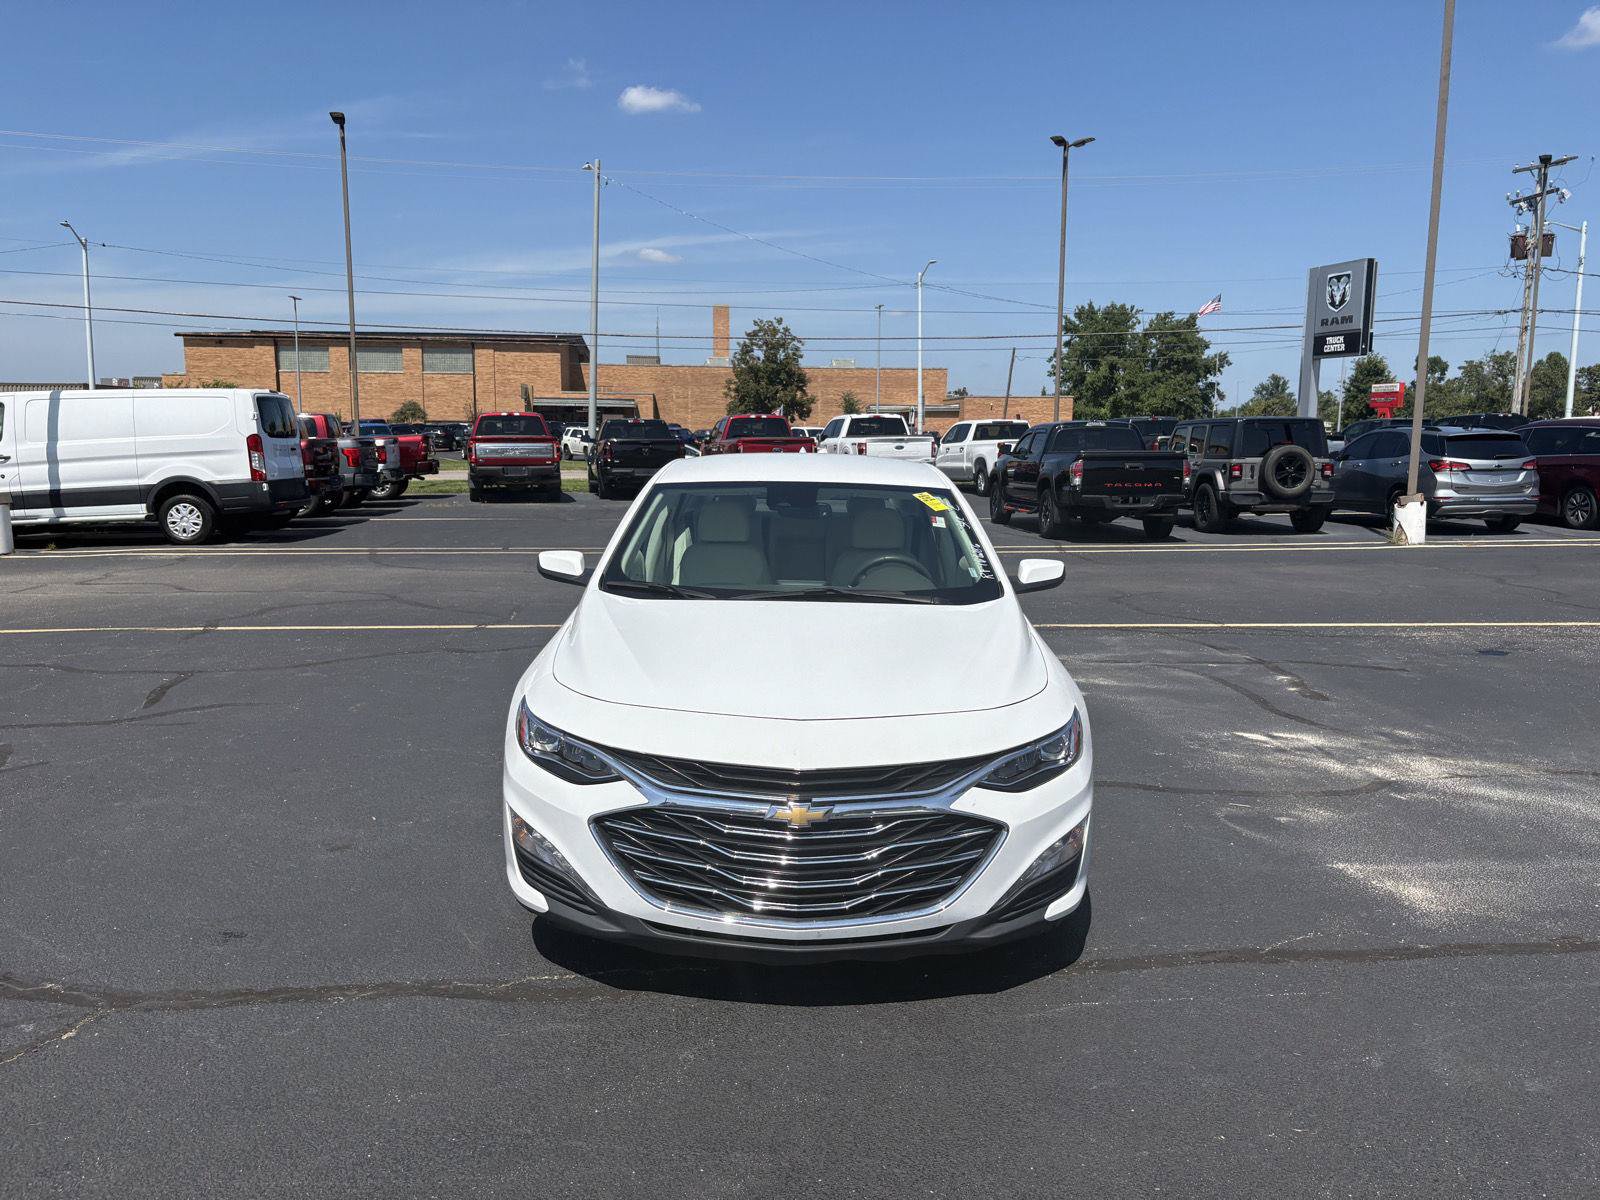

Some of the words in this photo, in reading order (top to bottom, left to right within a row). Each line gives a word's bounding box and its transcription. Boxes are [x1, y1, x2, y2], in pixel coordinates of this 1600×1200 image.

[1321, 315, 1353, 326] RAM
[1326, 336, 1344, 344] TRUCK
[1324, 344, 1345, 352] CENTER
